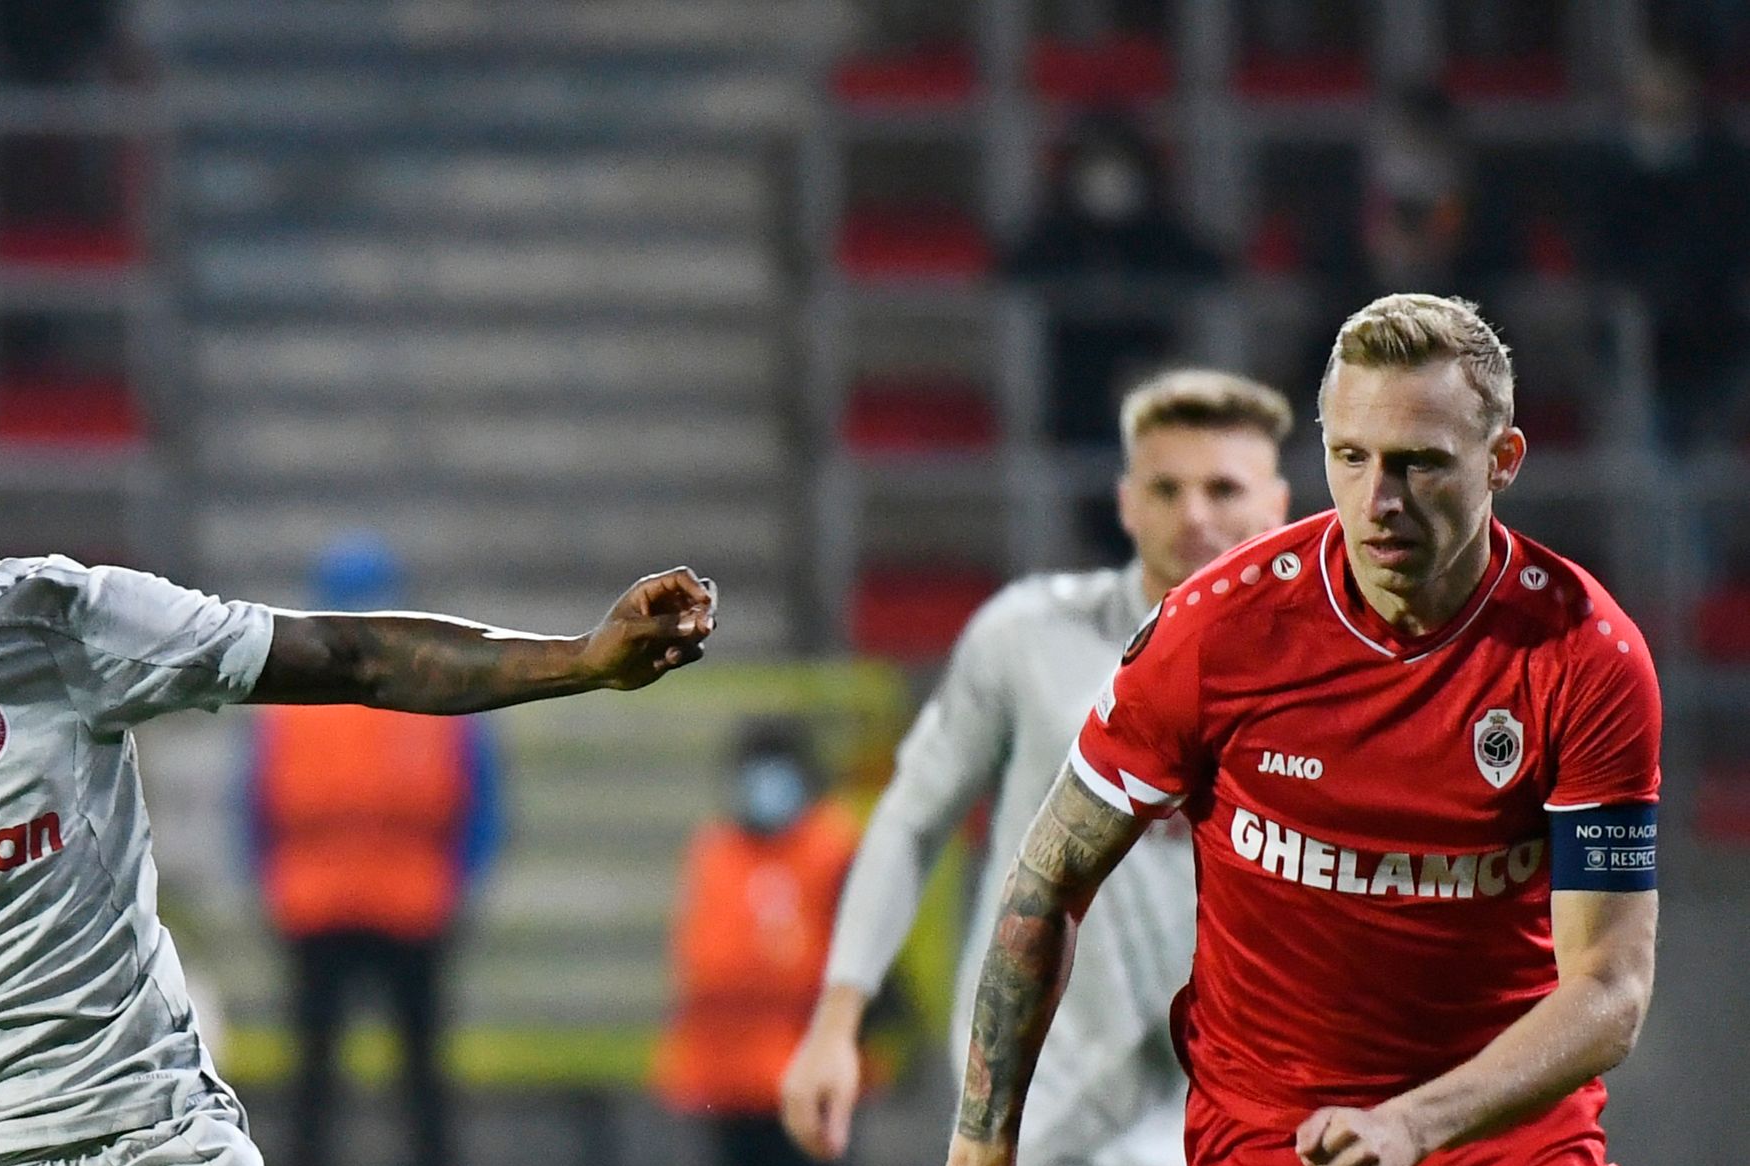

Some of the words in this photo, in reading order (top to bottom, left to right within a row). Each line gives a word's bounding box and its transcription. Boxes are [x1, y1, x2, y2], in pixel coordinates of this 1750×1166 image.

[1258, 751, 1323, 780] JAKO
[1494, 770, 1502, 783] 1
[1576, 825, 1602, 839] NO
[1605, 825, 1627, 839] TO
[1230, 807, 1545, 899] GHELAMCO
[1611, 850, 1656, 867] RESPECT
